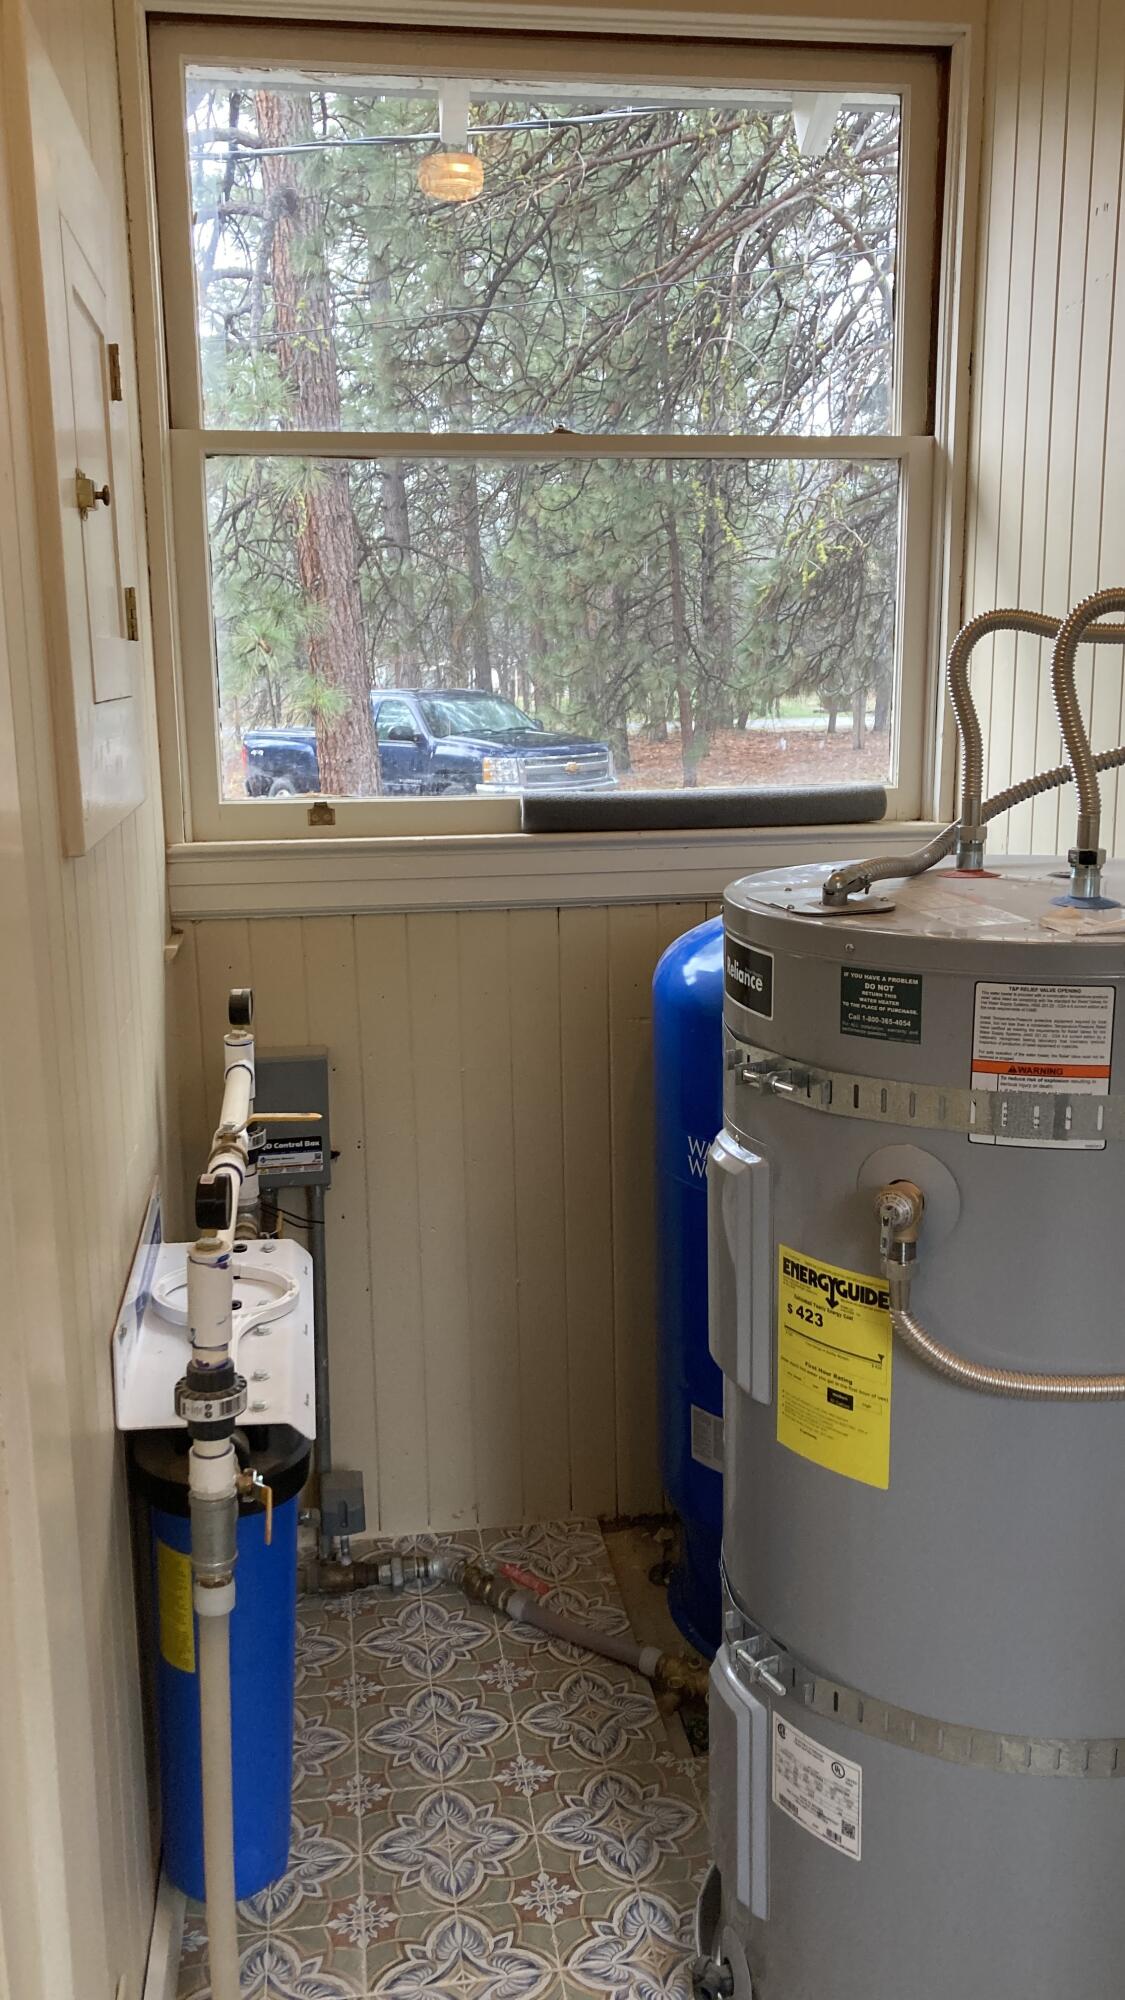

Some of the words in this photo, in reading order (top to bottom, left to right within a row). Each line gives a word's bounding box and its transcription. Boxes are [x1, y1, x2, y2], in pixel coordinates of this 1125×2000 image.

[727, 955, 763, 992] Reliance
[888, 977, 919, 985] PROBLEM
[864, 982, 875, 990] DO
[878, 984, 895, 992] NOT
[1018, 1066, 1063, 1075] WARNING
[273, 1140, 303, 1149] Control
[795, 1305, 824, 1328] 423
[833, 1373, 853, 1386] Rating
